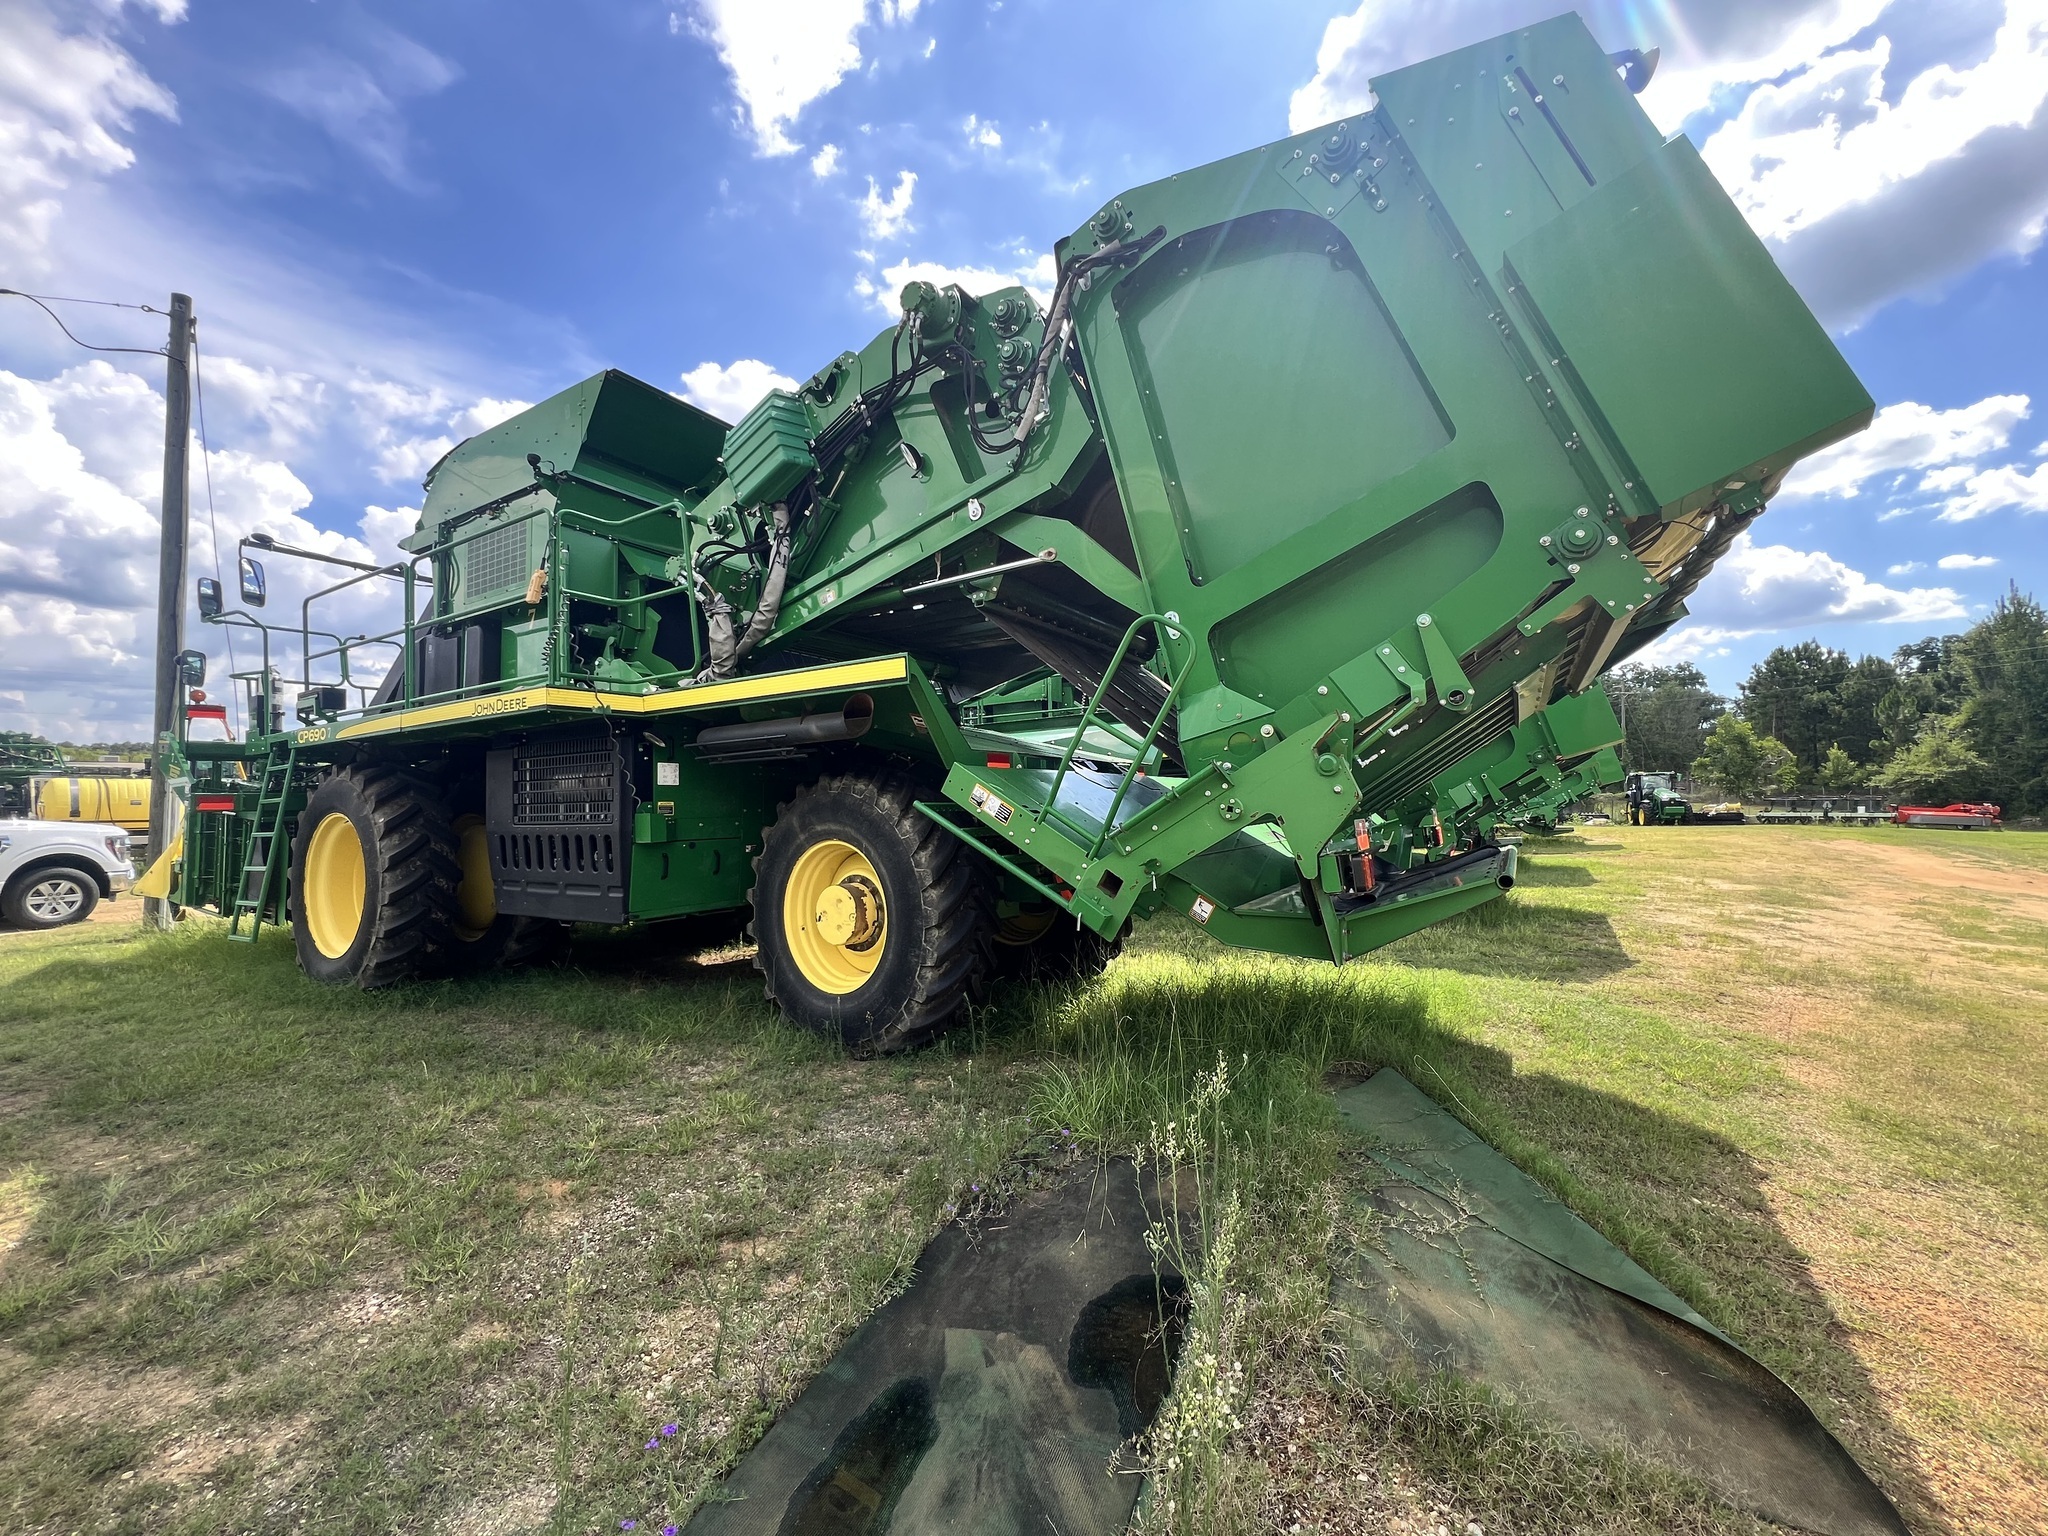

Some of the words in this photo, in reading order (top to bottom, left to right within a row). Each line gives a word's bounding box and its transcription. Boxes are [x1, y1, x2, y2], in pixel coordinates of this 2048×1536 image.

[471, 702, 496, 716] JOHN
[496, 697, 528, 712] DEERE
[297, 727, 326, 744] CP690
